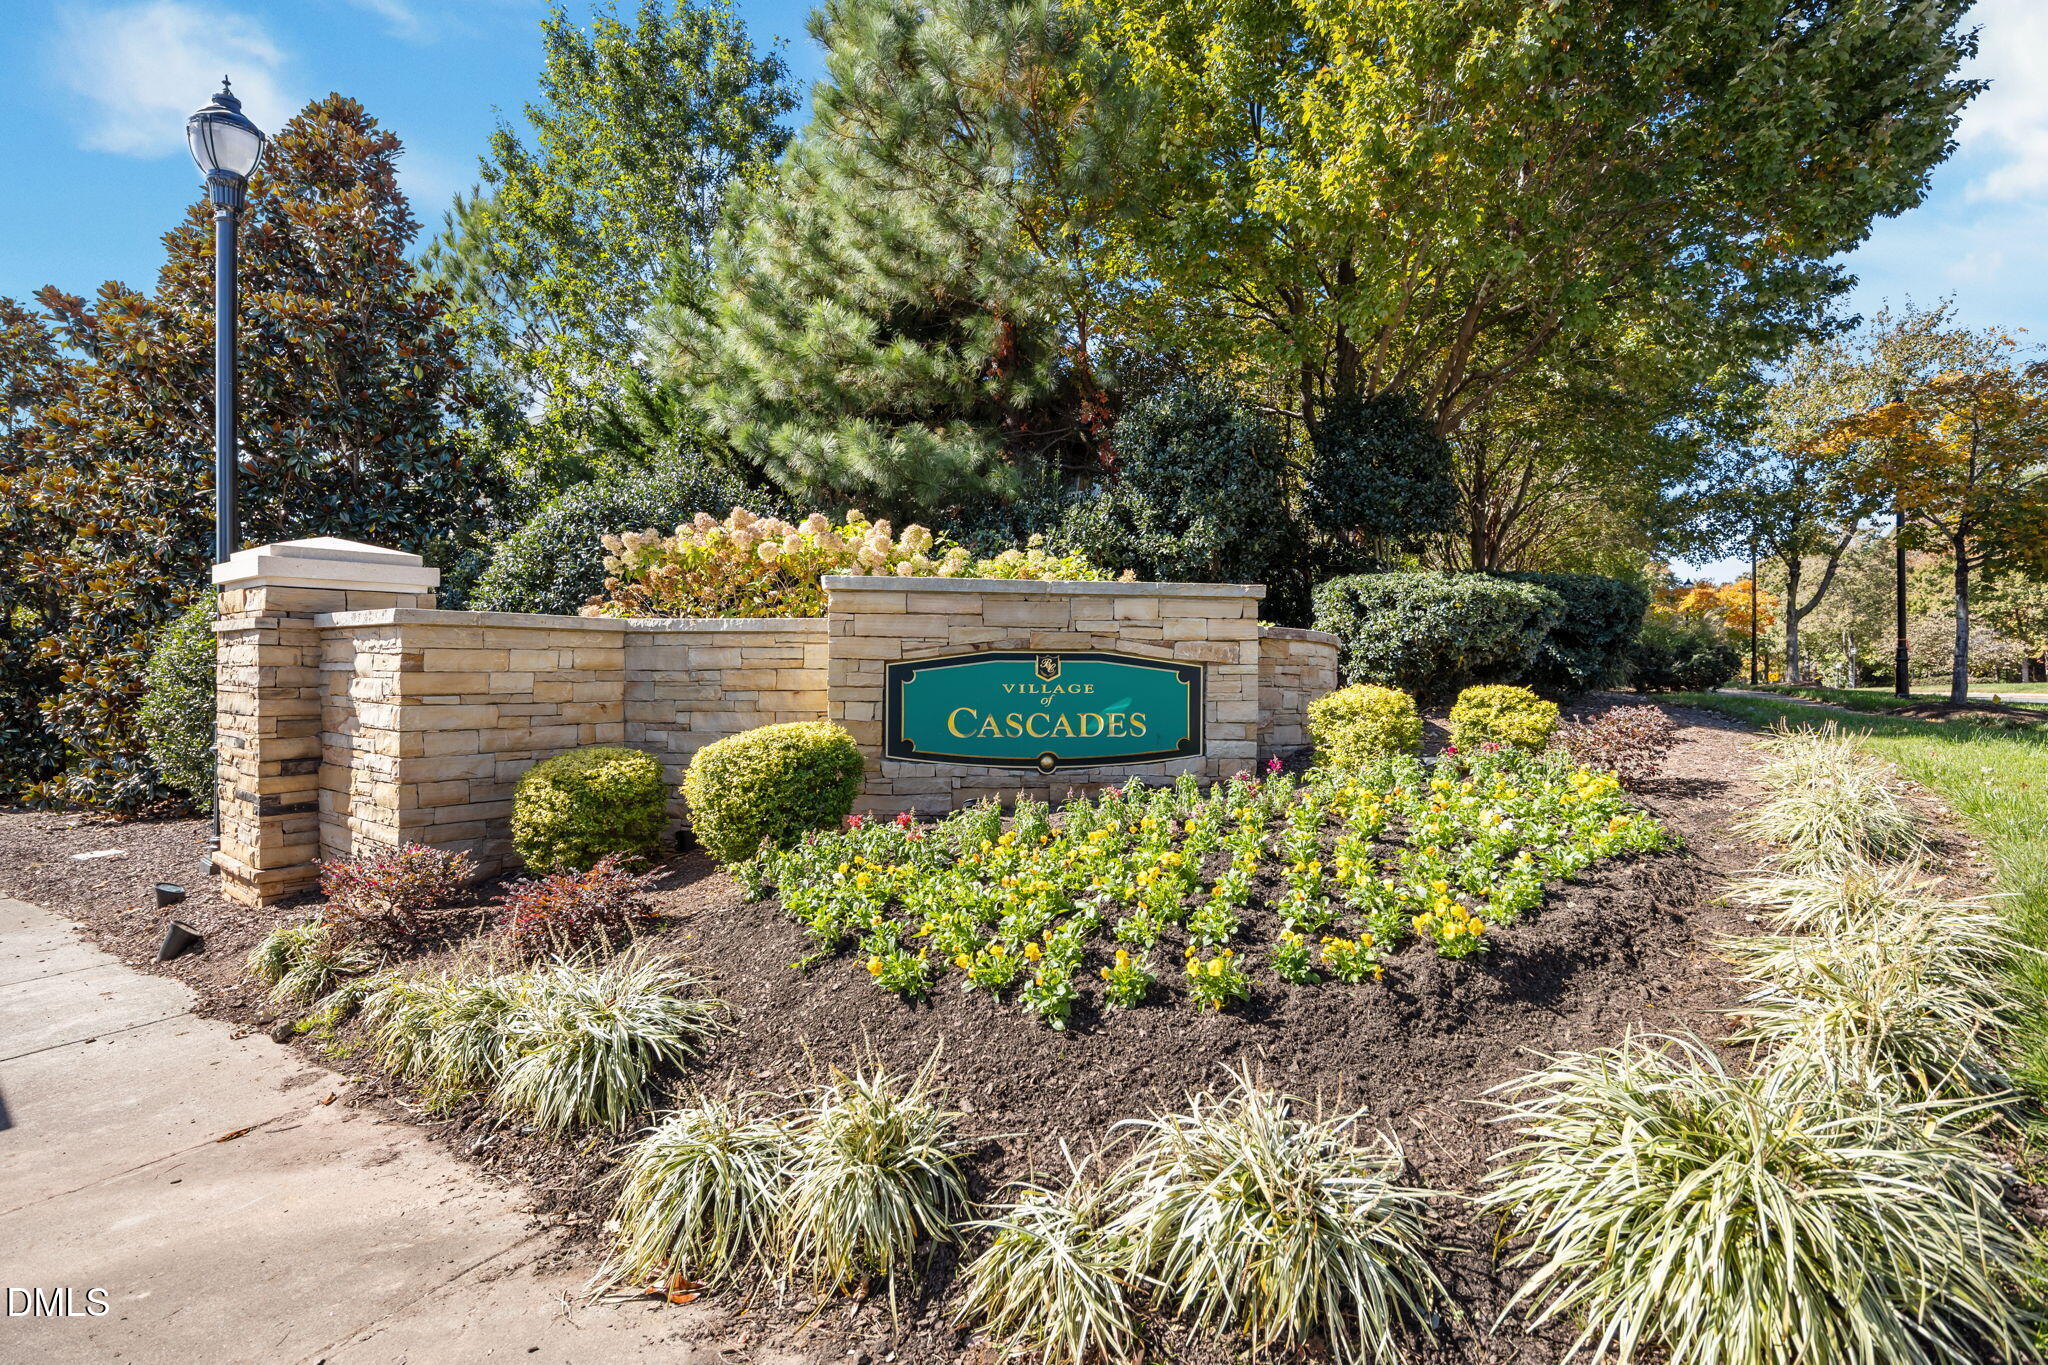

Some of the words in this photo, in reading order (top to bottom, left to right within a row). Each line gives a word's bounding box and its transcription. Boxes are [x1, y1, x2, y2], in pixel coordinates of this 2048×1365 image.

[1002, 683, 1095, 694] VILLAGE
[1040, 694, 1053, 707] of
[947, 707, 1147, 738] CASCADES
